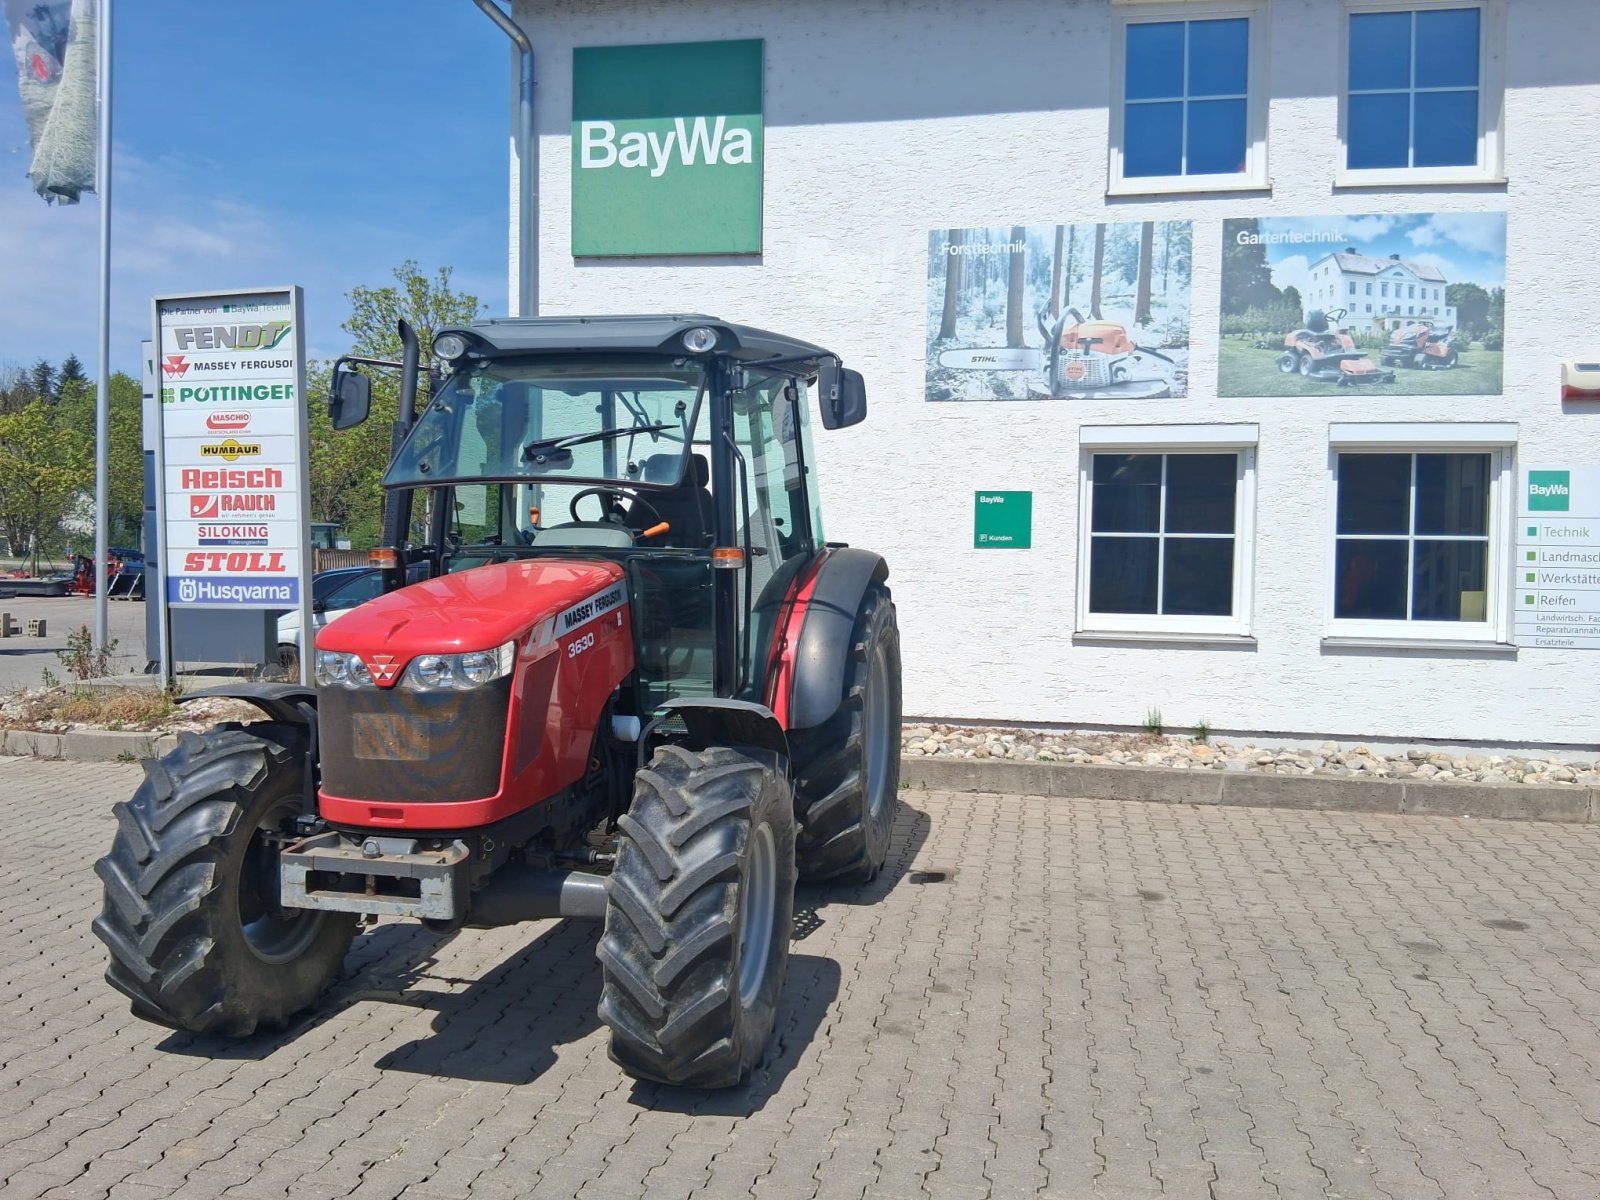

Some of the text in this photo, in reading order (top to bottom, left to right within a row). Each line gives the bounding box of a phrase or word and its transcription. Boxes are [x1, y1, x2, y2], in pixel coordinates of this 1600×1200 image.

[581, 116, 752, 177] BayWa
[1236, 229, 1348, 245] Gartentechnik.
[940, 239, 1027, 256] Forsttechnik
[161, 307, 174, 315] Die
[176, 307, 202, 315] Partner
[203, 306, 218, 314] von
[231, 303, 258, 314] BayWa
[174, 324, 284, 350] FENDT
[194, 361, 237, 371] MASSEY
[212, 413, 249, 421] MASCHIO
[203, 446, 259, 454] HUMBAUR
[182, 468, 282, 489] Reisch
[1529, 484, 1569, 497] BayWa
[221, 494, 275, 511] RAUCH
[980, 496, 1004, 504] BayWa
[198, 526, 268, 538] SILOKING
[1543, 526, 1590, 537] Technik
[183, 552, 286, 572] STOLL
[198, 581, 290, 602] Husqvarna
[1540, 594, 1576, 606] Reifen
[564, 602, 594, 629] MASSEY
[1536, 613, 1586, 622] Landwirtsch.
[567, 632, 594, 658] 3630
[1535, 638, 1575, 646] Ersatzteile
